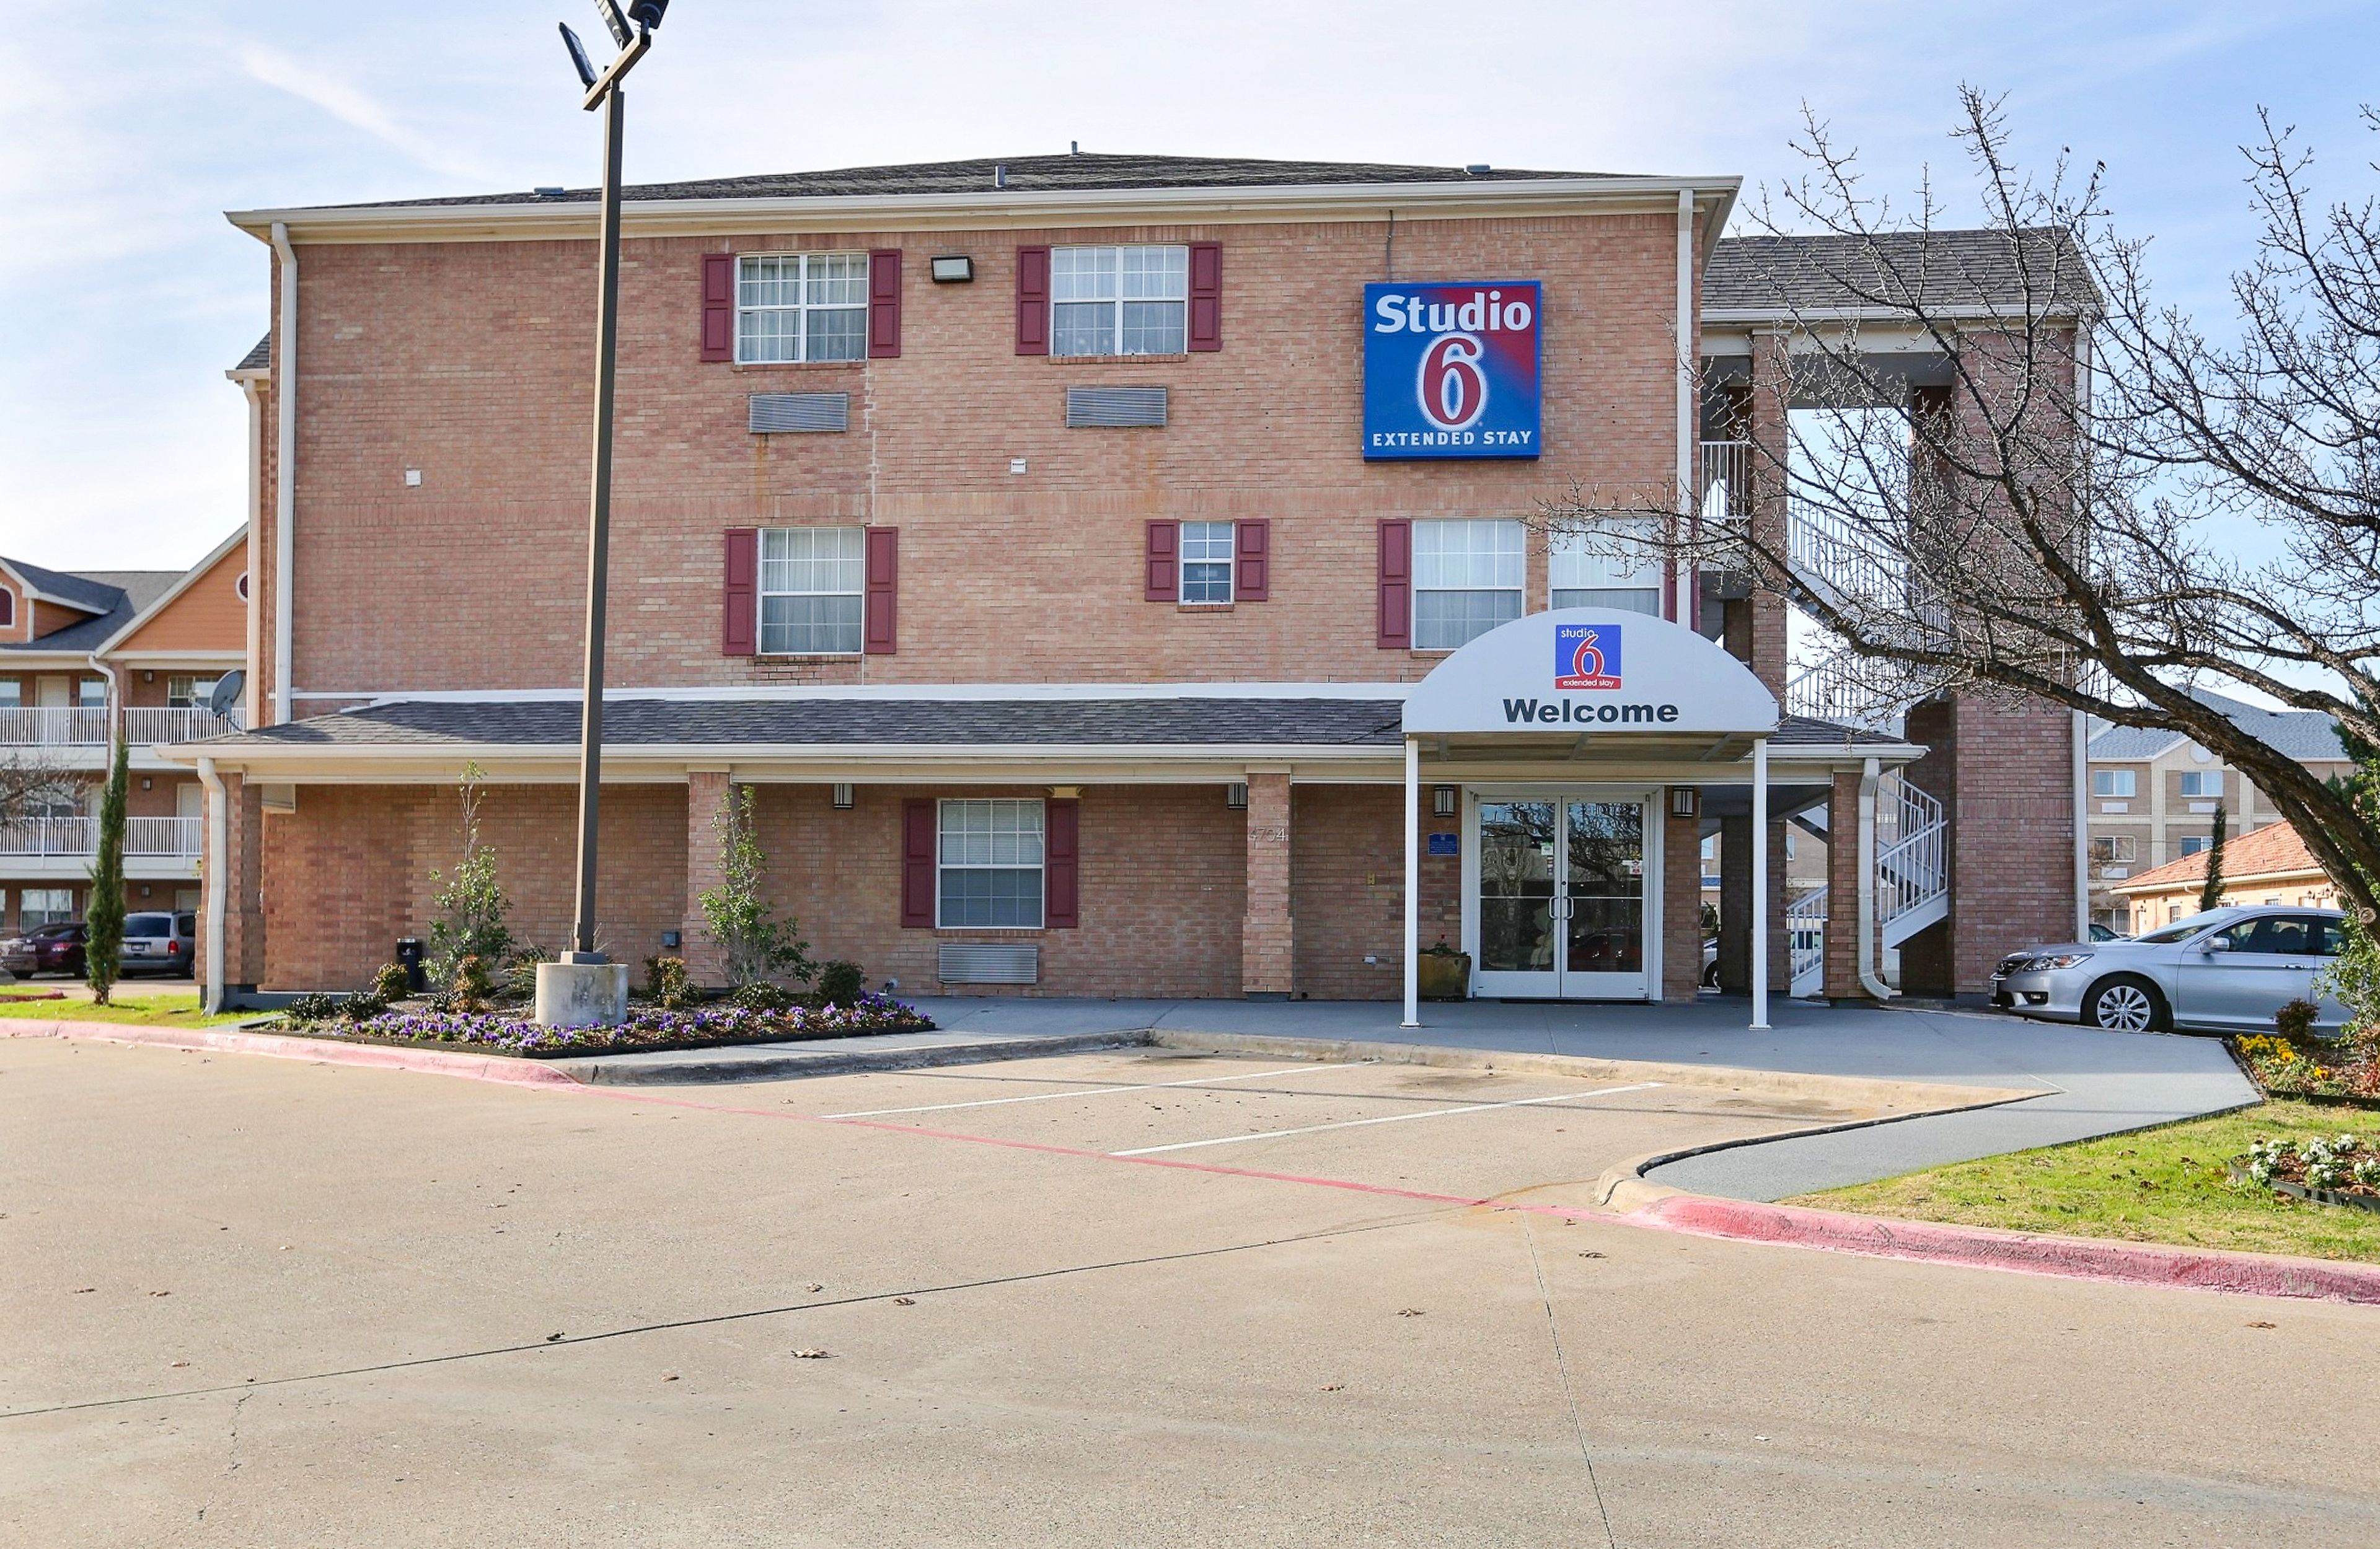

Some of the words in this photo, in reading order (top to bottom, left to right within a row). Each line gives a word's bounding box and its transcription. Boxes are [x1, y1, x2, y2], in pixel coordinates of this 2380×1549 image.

[1375, 291, 1532, 333] Studio
[1422, 335, 1483, 428] 6
[1373, 432, 1475, 446] EXTENDED
[1483, 431, 1532, 444] STAY
[1561, 628, 1595, 638] studio
[1572, 634, 1605, 677] 6
[1598, 680, 1615, 688] stay
[1502, 698, 1679, 723] Welcome
